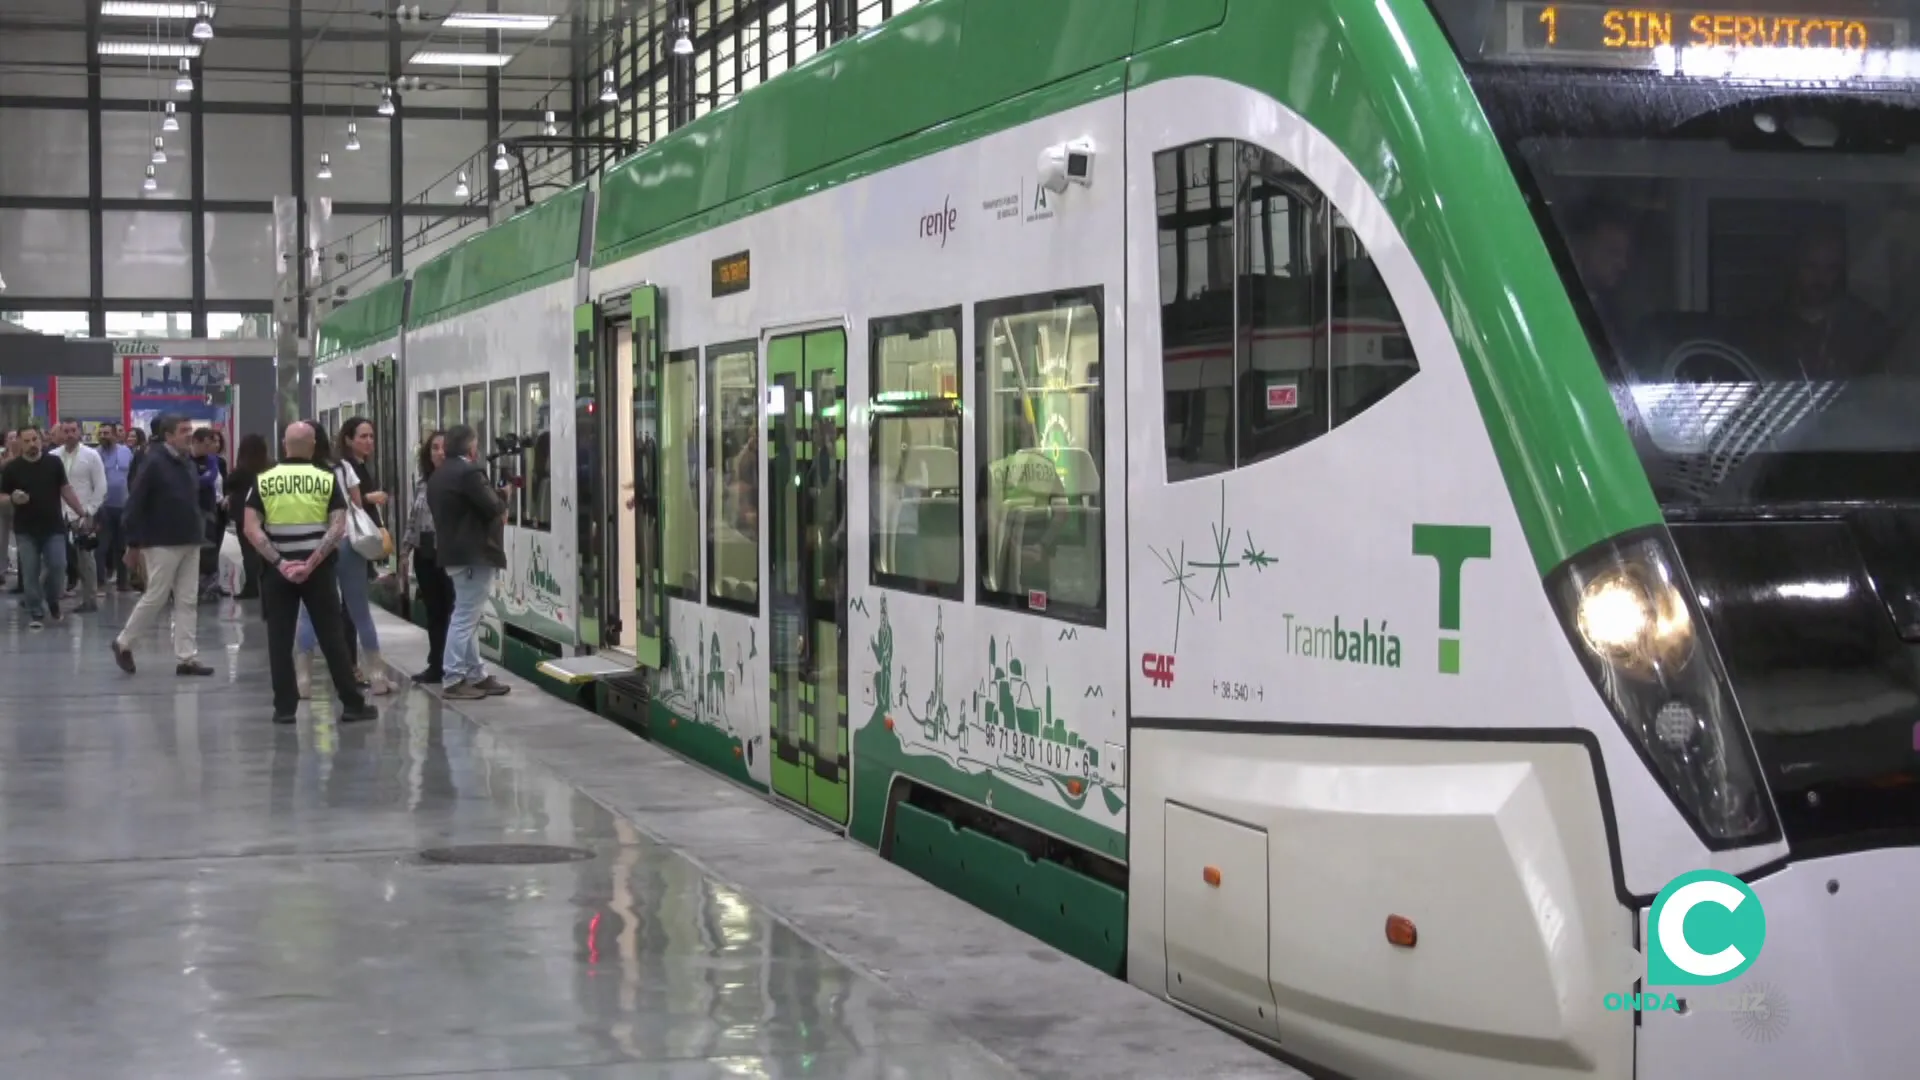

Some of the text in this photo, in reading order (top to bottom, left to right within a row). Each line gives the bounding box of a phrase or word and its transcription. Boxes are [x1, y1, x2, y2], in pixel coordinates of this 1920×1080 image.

[1540, 7, 1557, 45] 1
[1603, 9, 1672, 48] SIN
[920, 193, 957, 248] renfe
[260, 474, 331, 498] SEGURIDAD
[1282, 613, 1401, 669] Trambahía
[1141, 652, 1175, 689] CAF
[1221, 680, 1249, 702] 38.540
[985, 723, 996, 748] 96
